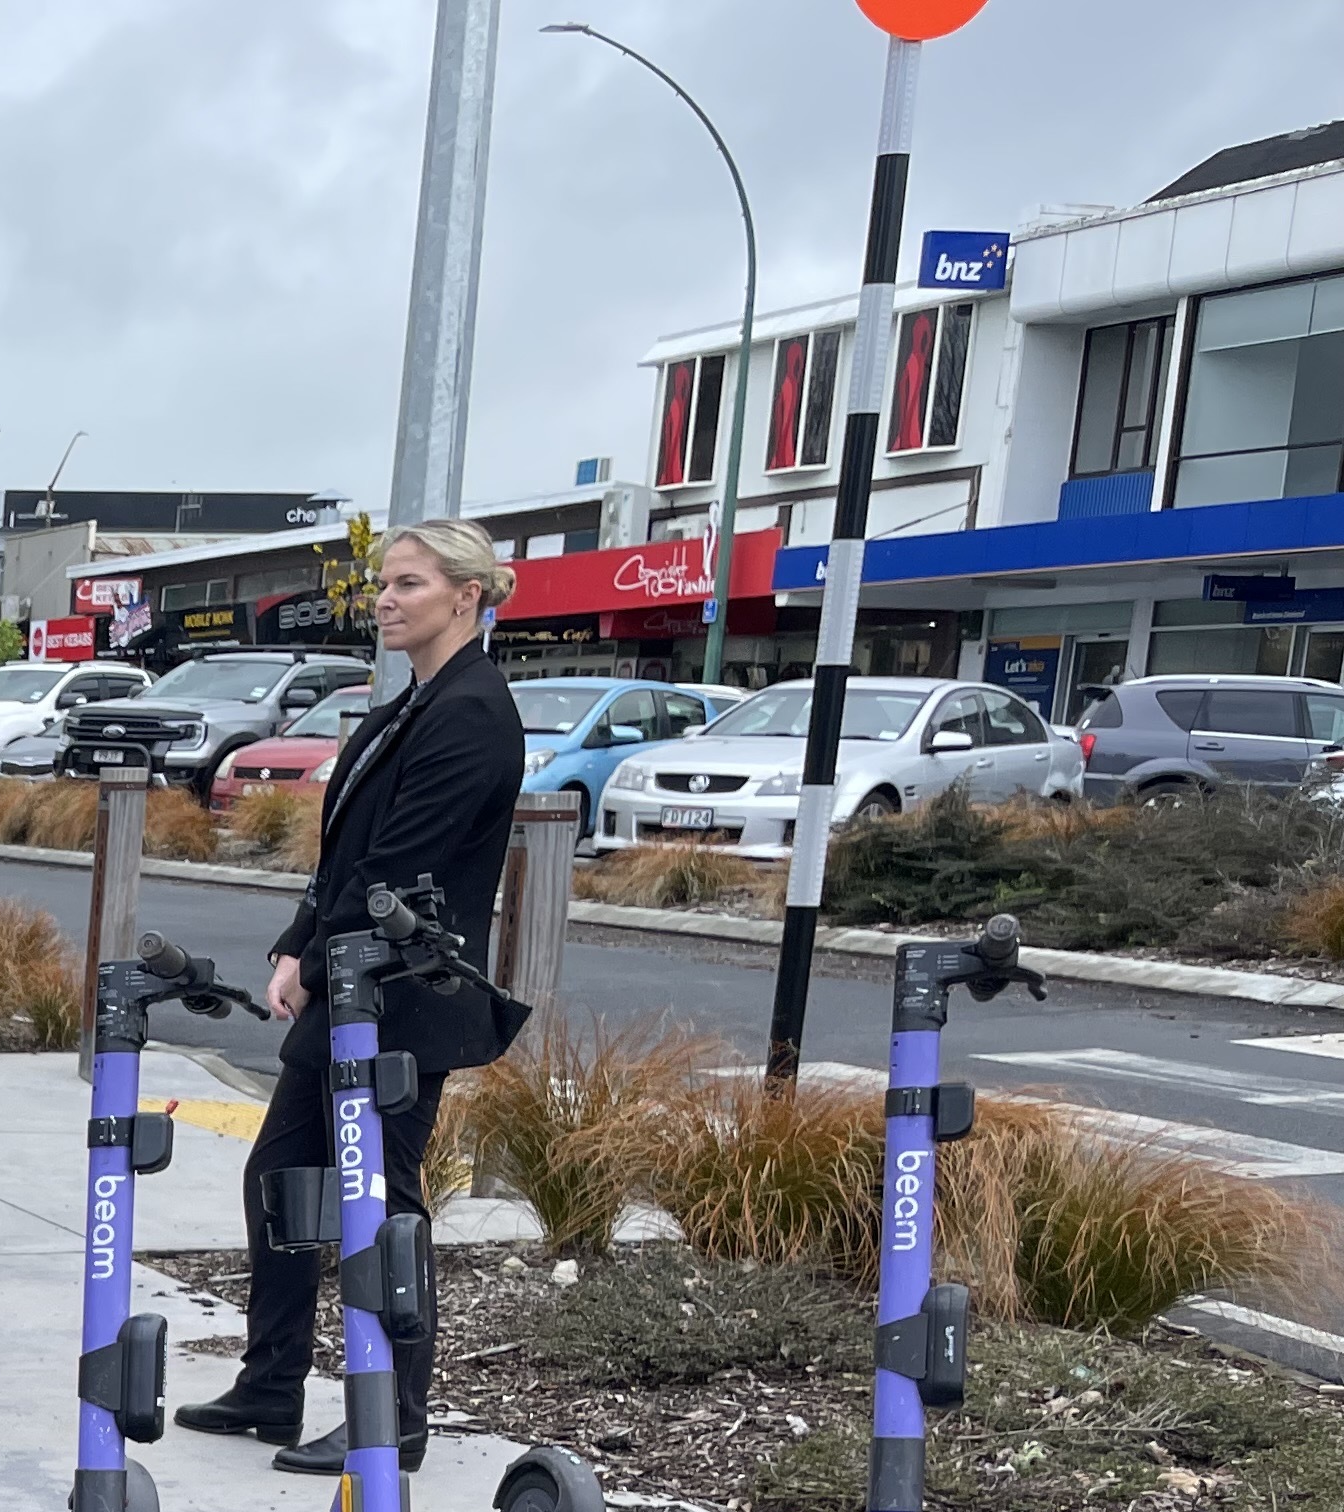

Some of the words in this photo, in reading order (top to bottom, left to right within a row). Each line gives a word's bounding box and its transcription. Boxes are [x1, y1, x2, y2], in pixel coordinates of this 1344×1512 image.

[935, 253, 983, 282] bnz
[278, 599, 333, 630] BOD
[339, 1097, 370, 1201] beam
[92, 1175, 127, 1279] beam
[892, 1150, 929, 1251] beam
